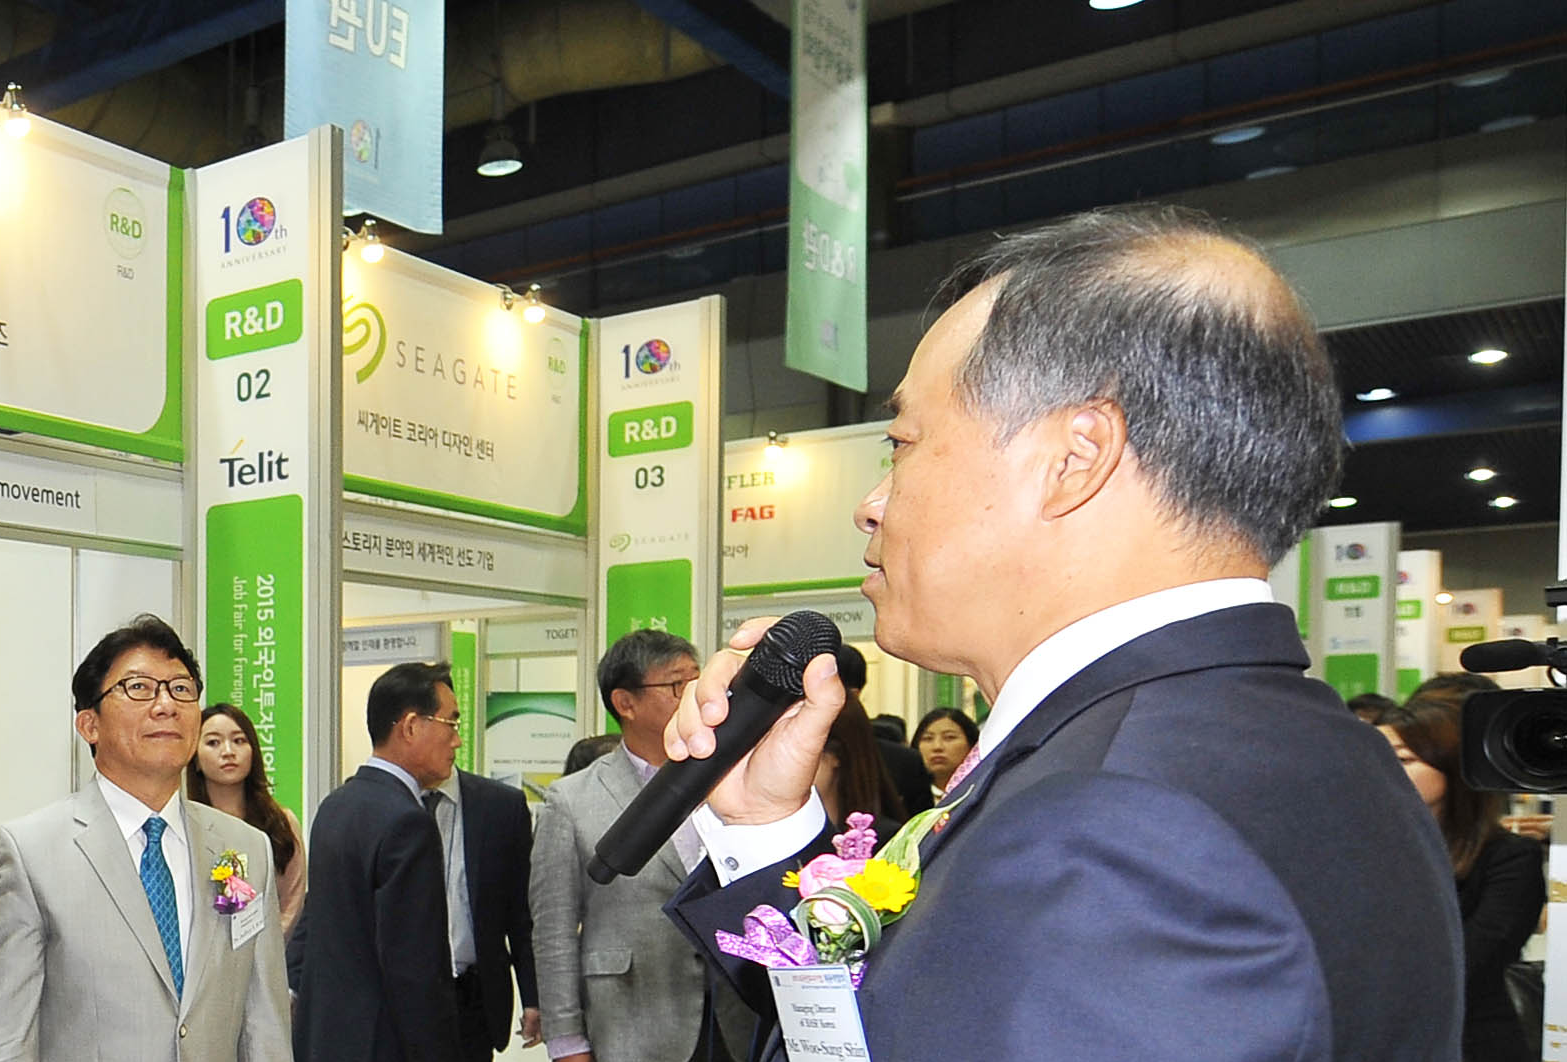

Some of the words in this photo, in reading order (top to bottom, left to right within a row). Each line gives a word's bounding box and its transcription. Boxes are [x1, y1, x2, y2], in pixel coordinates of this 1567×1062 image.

[110, 213, 142, 239] R&D
[224, 301, 285, 340] R&D
[396, 340, 518, 400] SEAGATE
[236, 369, 272, 402] 02
[357, 409, 403, 439] 씨게이트
[406, 421, 439, 448] 코리아
[442, 430, 474, 457] 디자인
[476, 439, 495, 461] 센터
[624, 416, 677, 443] R&D
[220, 441, 289, 488] Telit
[635, 465, 665, 489] 03
[731, 505, 775, 522] FAG
[477, 551, 494, 571] 기업
[233, 576, 248, 600] Job
[256, 574, 276, 621] 2015
[233, 604, 248, 630] Fair
[233, 634, 248, 653] for
[545, 628, 578, 640] TOGET
